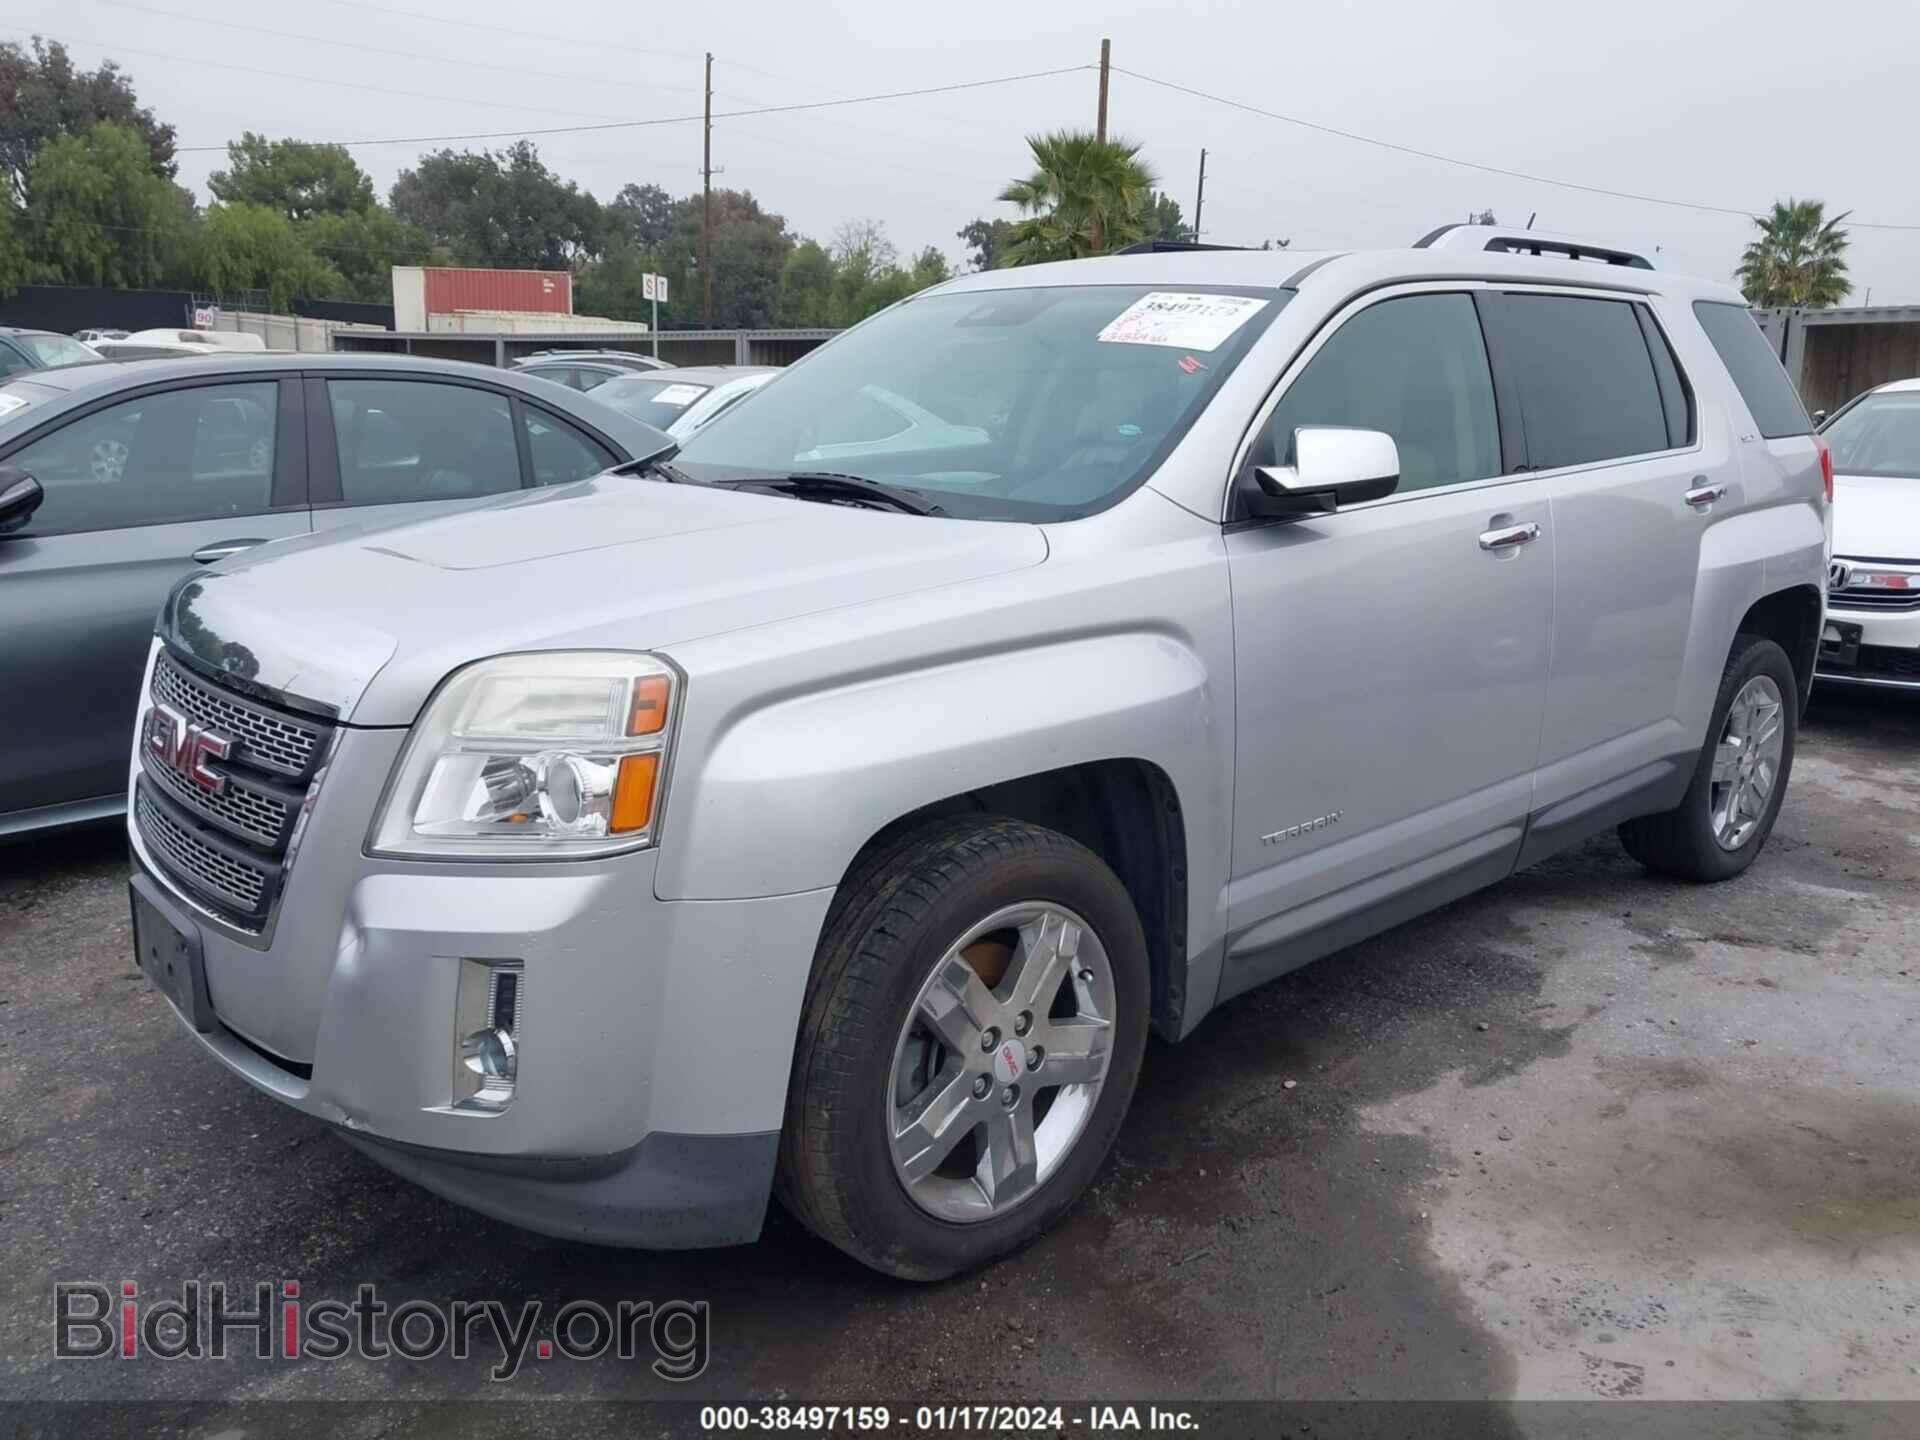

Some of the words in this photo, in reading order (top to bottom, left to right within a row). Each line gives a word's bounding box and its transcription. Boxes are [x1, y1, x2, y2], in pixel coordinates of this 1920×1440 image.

[149, 703, 231, 794] GMC
[1261, 809, 1344, 847] TERRAIN
[1003, 1046, 1019, 1077] GMC
